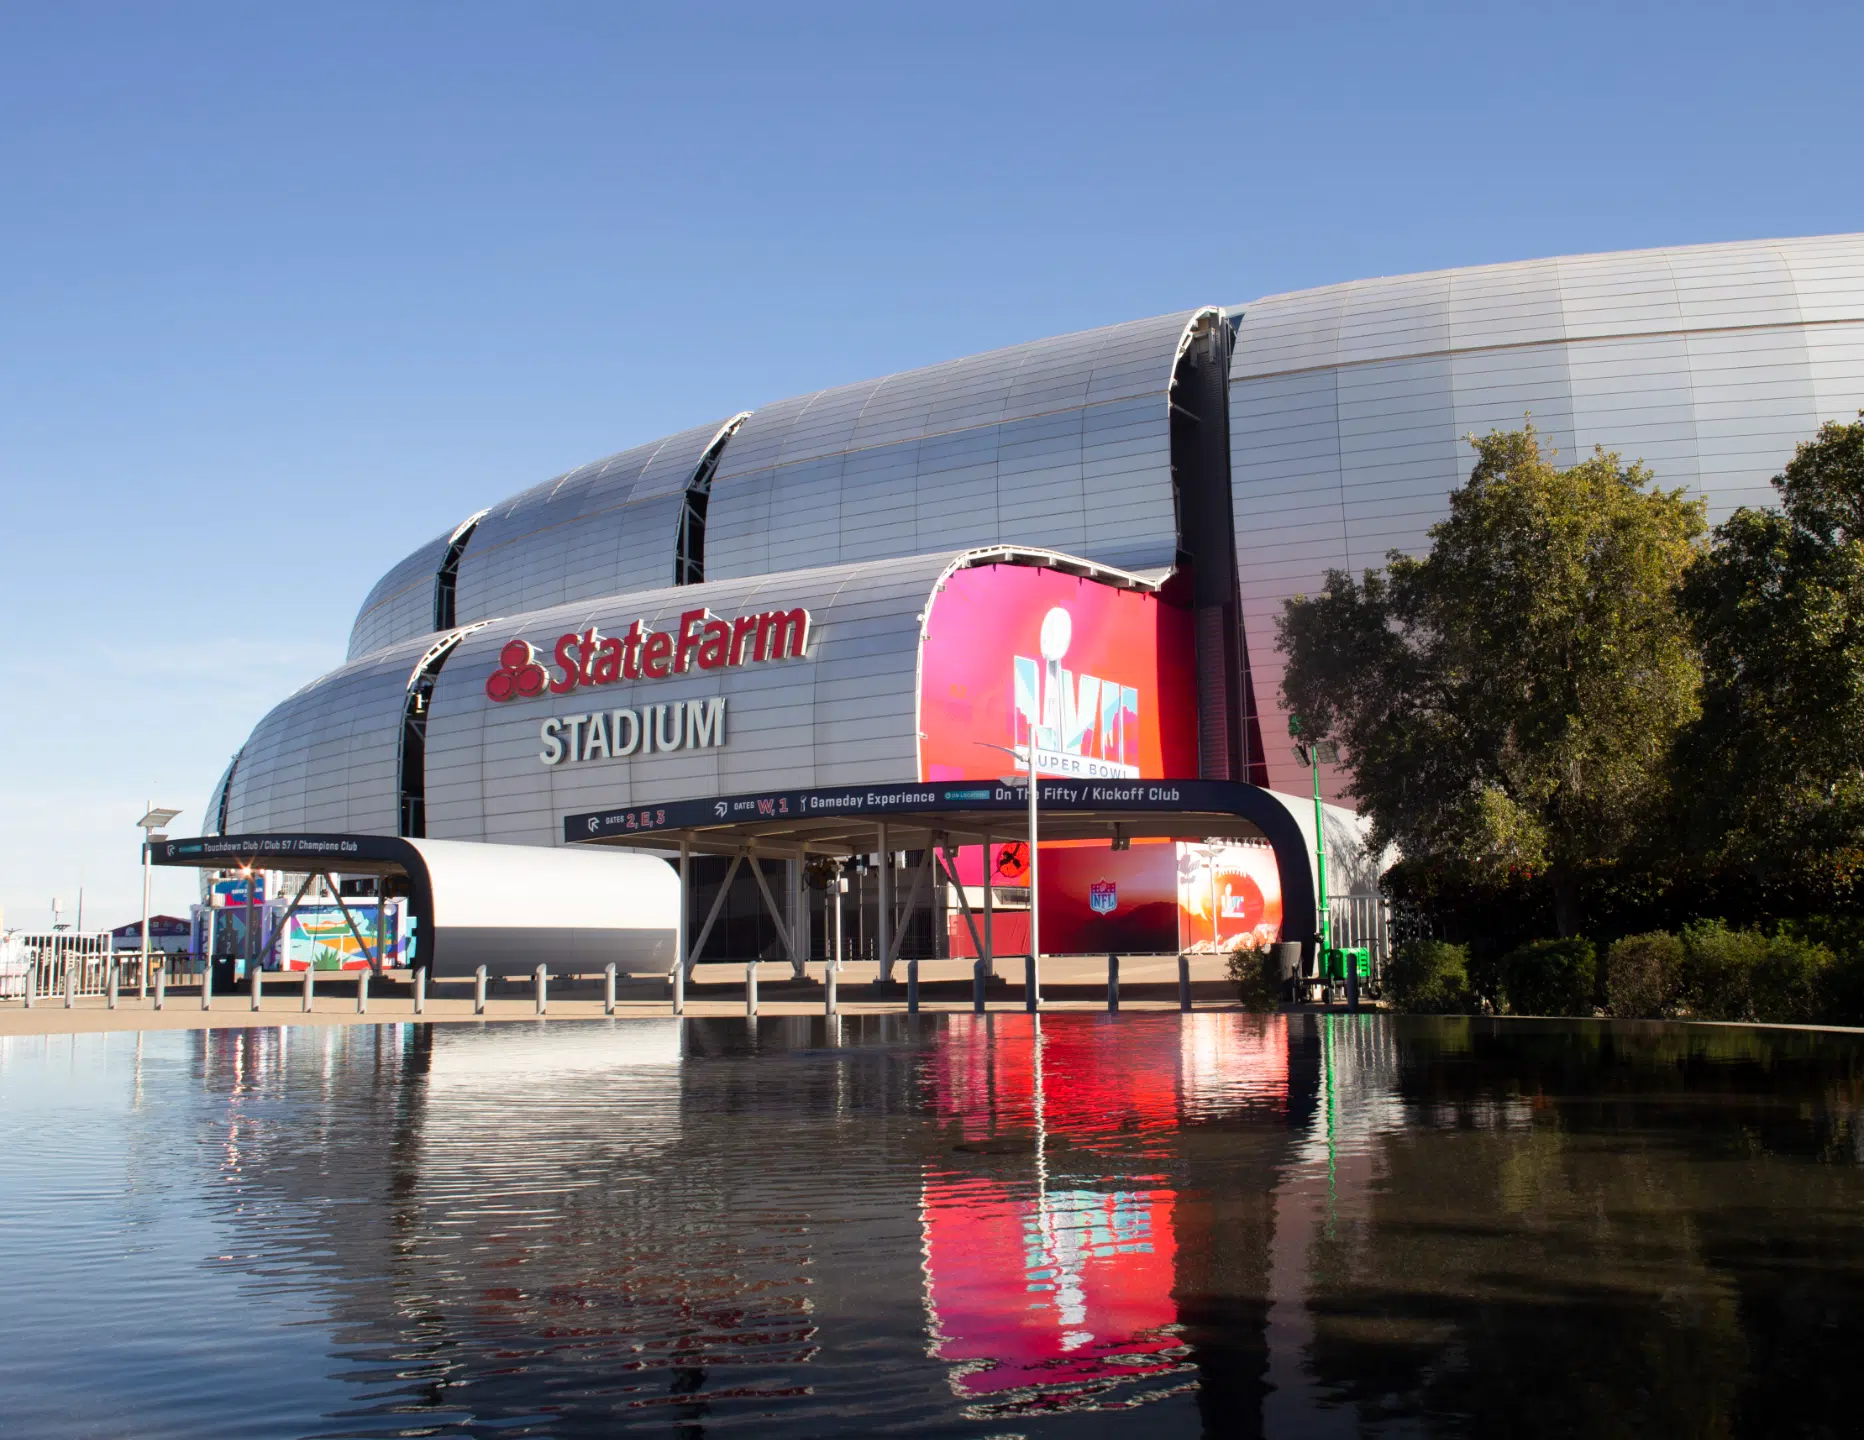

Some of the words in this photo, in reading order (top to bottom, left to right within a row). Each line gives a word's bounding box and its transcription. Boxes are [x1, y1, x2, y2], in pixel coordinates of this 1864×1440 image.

[539, 697, 727, 765] STADIUM
[1037, 755, 1080, 773] UPER
[810, 795, 863, 809] Gameday
[867, 791, 935, 806] Experience
[995, 787, 1012, 801] On
[1044, 787, 1078, 803] Fifty
[1092, 787, 1145, 801] Kickoff
[1148, 787, 1180, 801] Club
[733, 802, 755, 811] GATES
[779, 798, 788, 813] 1
[605, 815, 625, 825] GATES
[656, 809, 665, 824] 3
[204, 843, 242, 852] Touchdown
[243, 840, 258, 850] Club
[264, 840, 281, 850] Club
[282, 840, 292, 849] 57
[299, 840, 339, 851] Champions
[341, 841, 358, 851] Club
[1094, 894, 1114, 909] NFL
